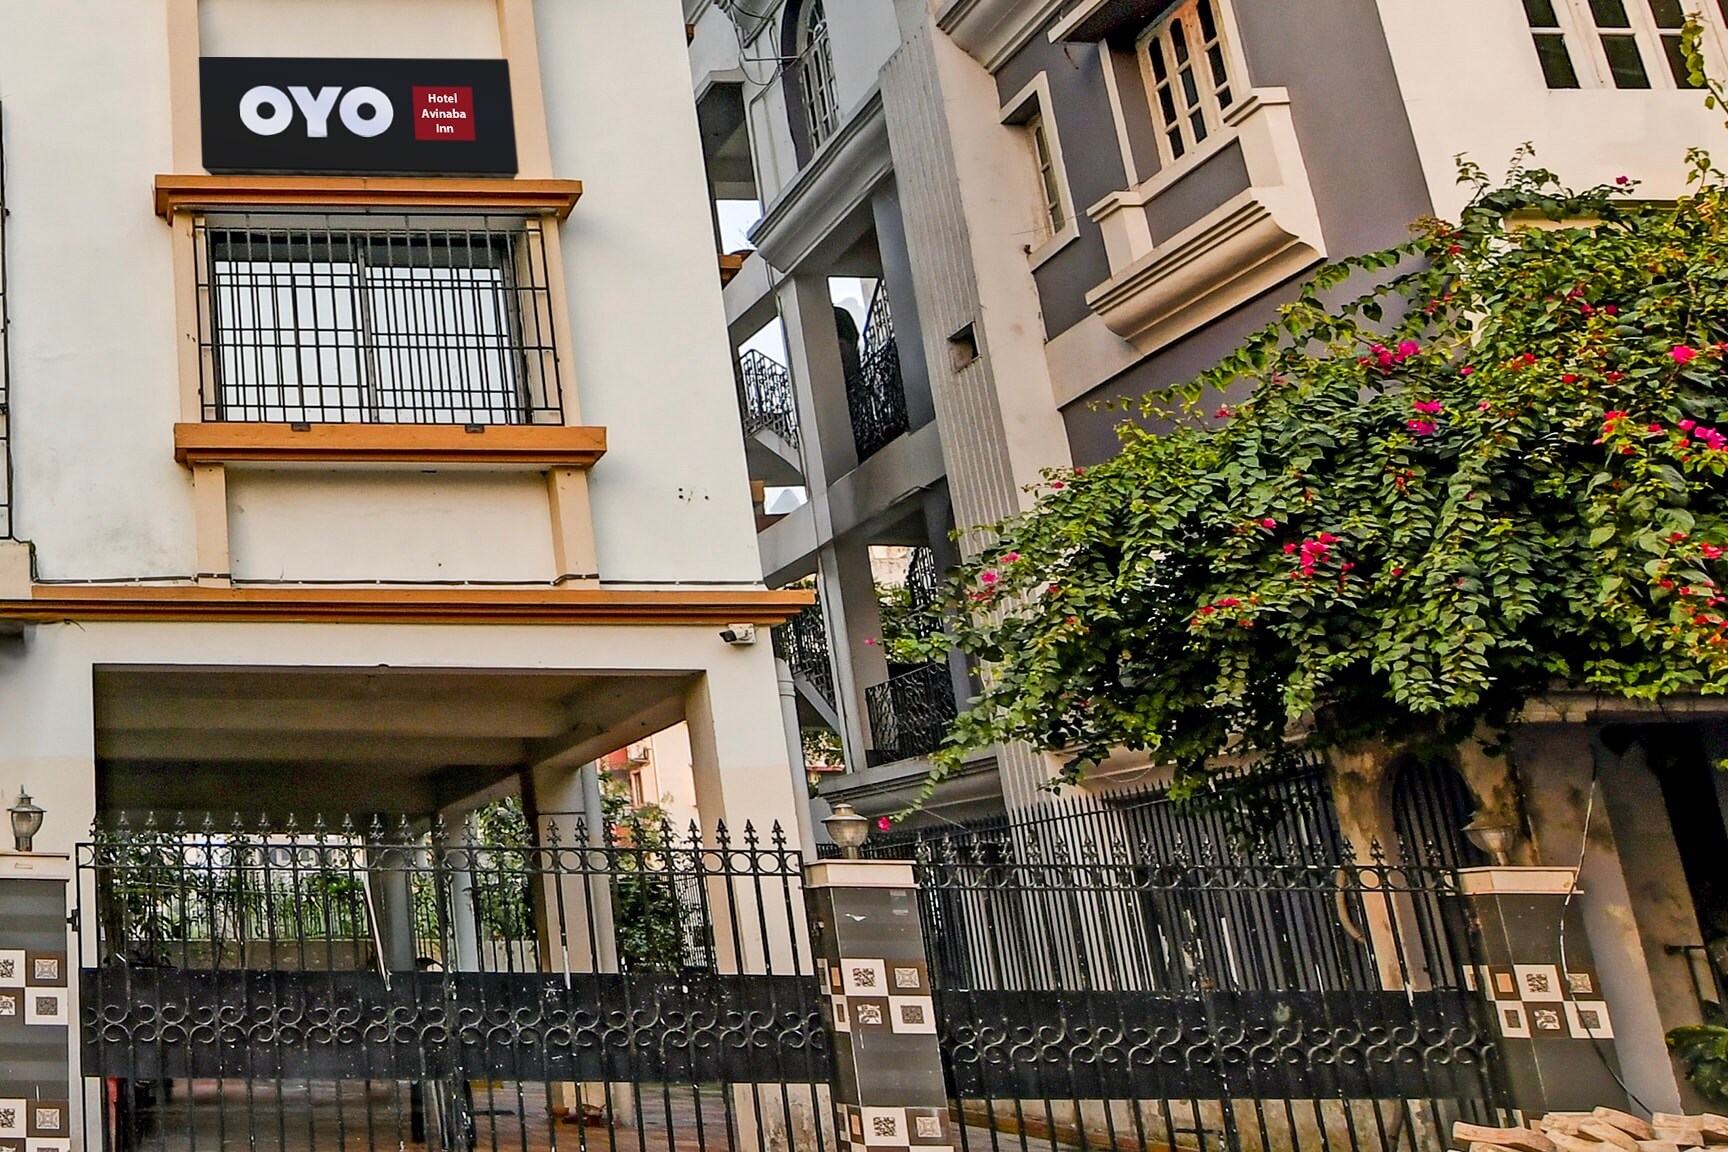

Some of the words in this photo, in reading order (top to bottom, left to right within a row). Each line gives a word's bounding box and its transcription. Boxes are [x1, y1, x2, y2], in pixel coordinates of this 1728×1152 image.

[427, 92, 458, 104] Hotel
[239, 85, 394, 138] OYO
[421, 108, 467, 119] Avinaba
[435, 123, 454, 134] Inn
